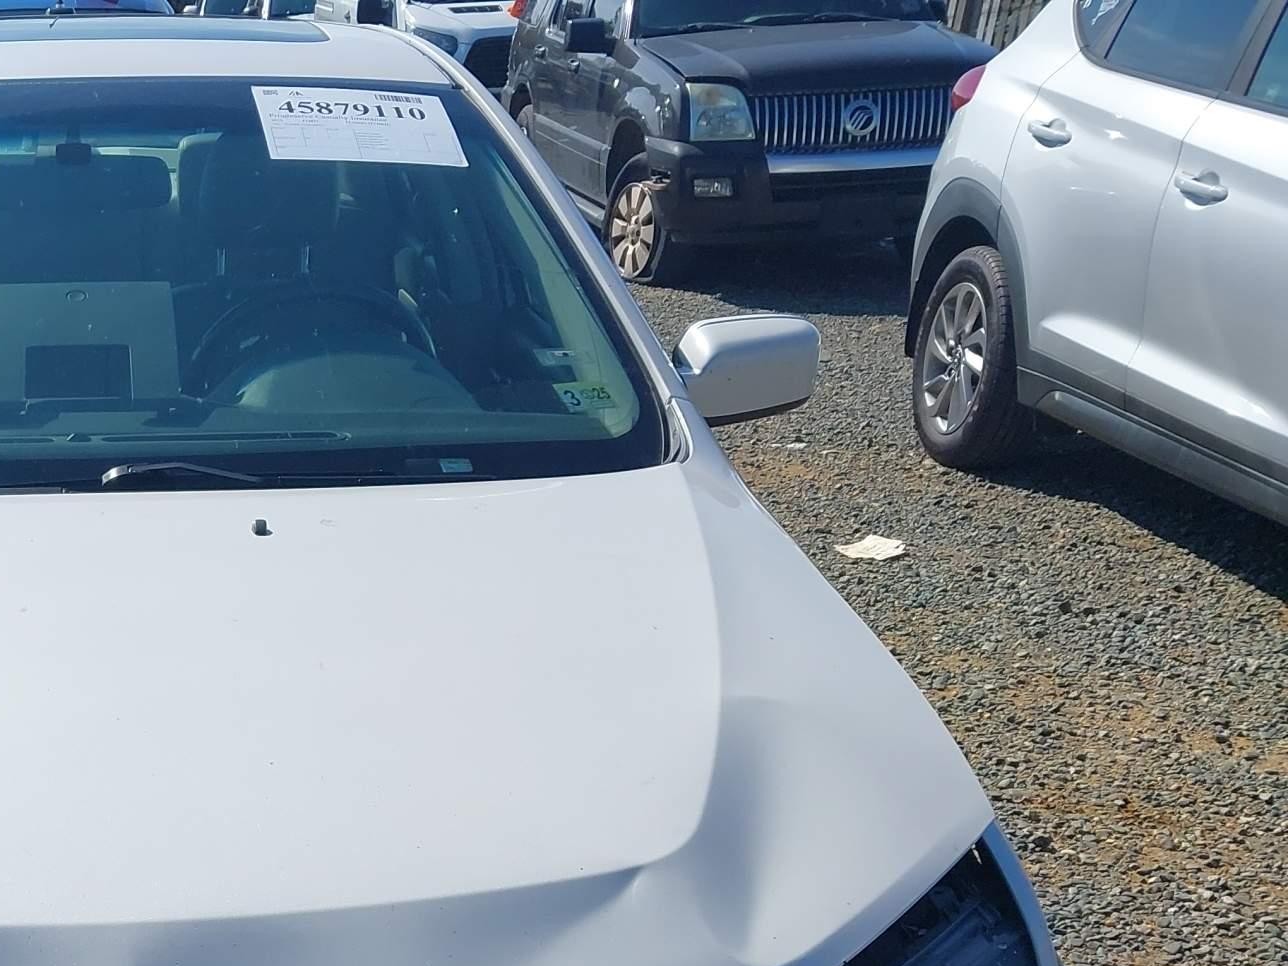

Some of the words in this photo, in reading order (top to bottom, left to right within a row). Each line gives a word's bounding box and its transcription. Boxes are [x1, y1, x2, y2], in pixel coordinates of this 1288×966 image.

[278, 100, 426, 121] 45879110
[563, 390, 581, 406] 3
[591, 387, 611, 400] 25
